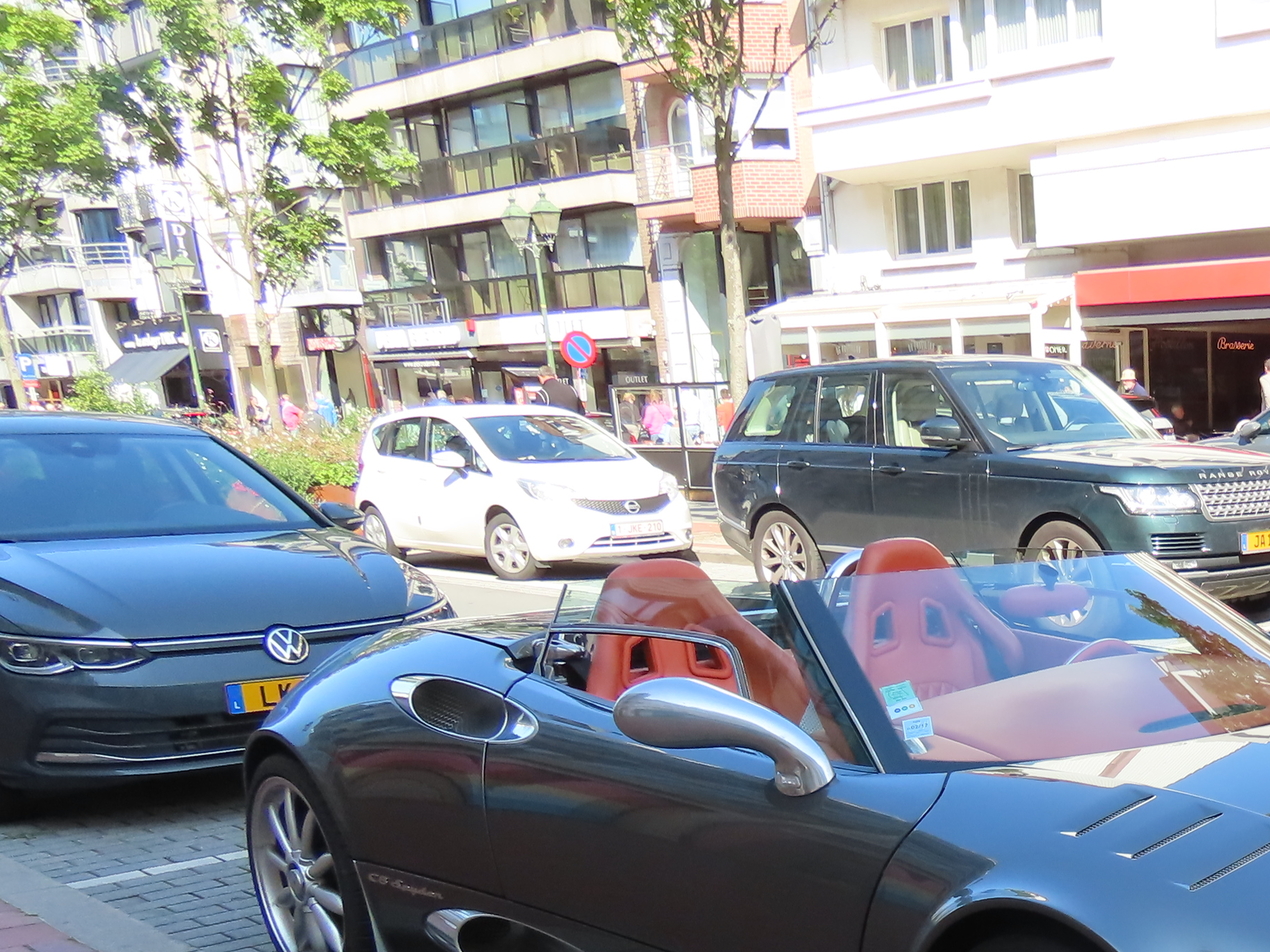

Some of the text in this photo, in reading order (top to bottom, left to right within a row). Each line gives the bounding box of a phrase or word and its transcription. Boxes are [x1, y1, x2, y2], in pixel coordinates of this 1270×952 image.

[1217, 336, 1255, 350] Brasserie
[20, 356, 32, 372] P
[625, 375, 649, 384] OUTLET
[1198, 471, 1243, 480] RANGE
